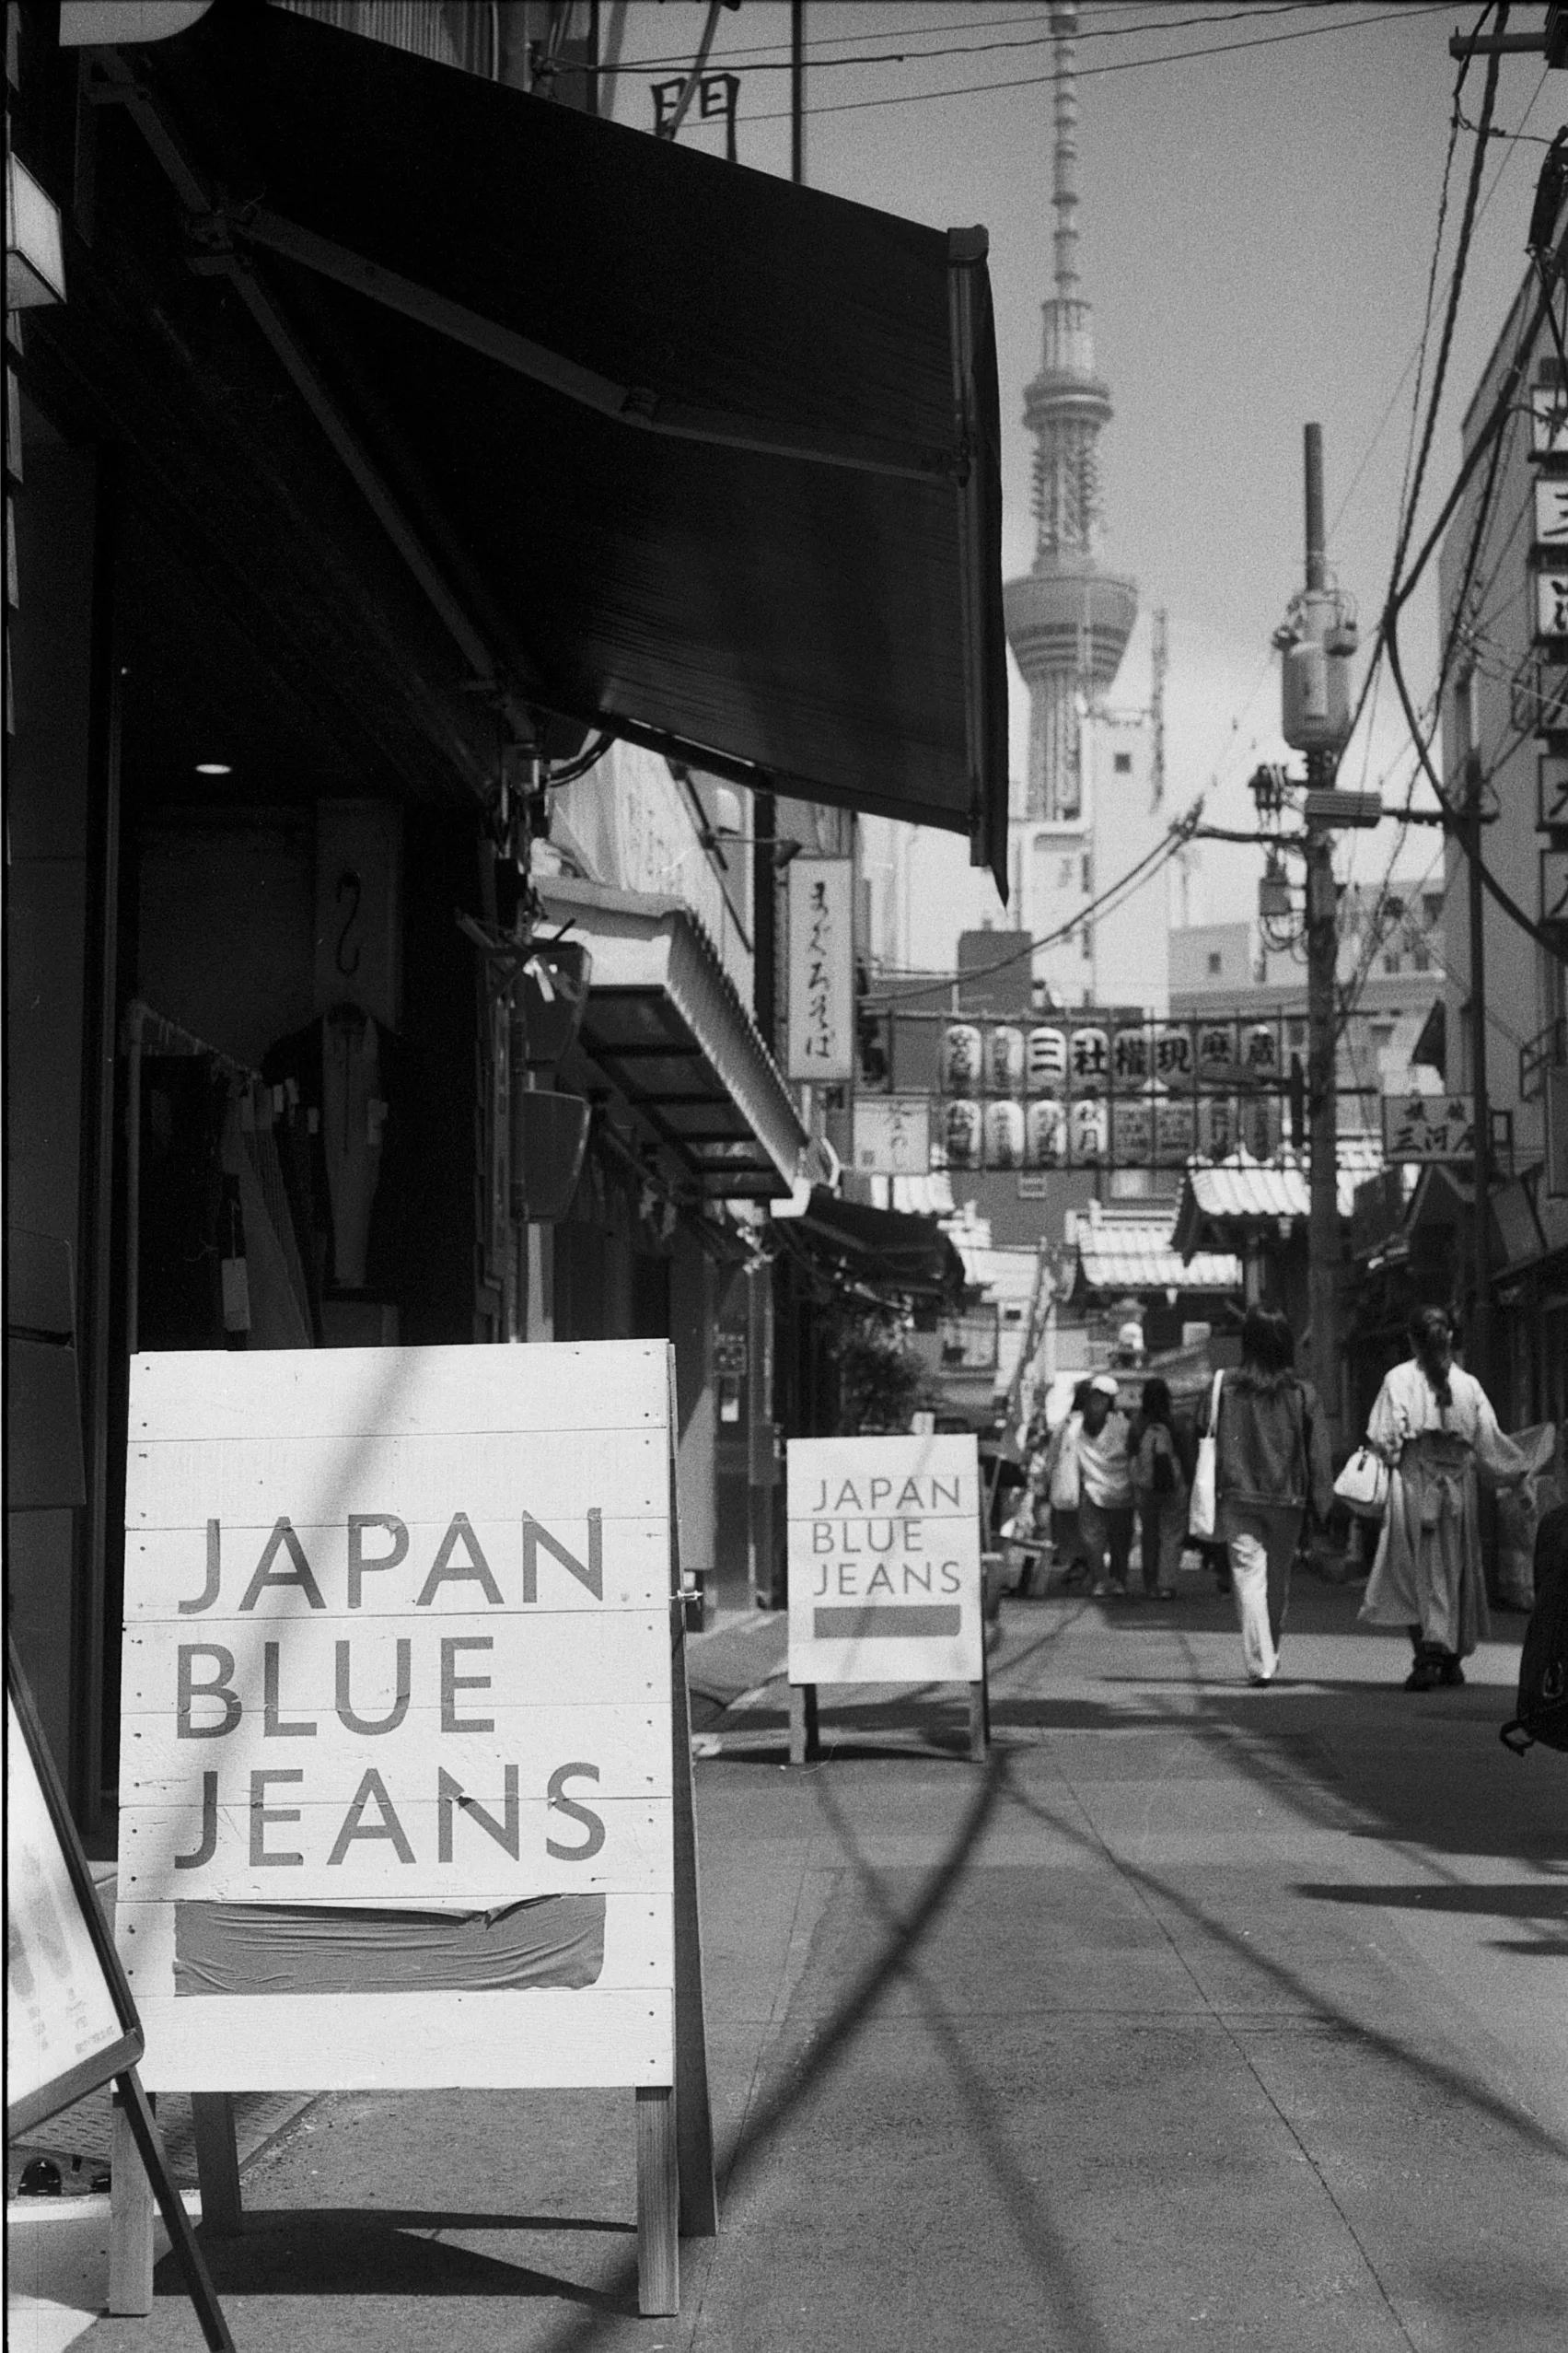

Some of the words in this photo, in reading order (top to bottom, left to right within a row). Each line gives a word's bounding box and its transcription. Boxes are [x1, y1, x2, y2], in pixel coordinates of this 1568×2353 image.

[812, 1476, 960, 1512] JAPAN
[178, 1507, 603, 1614] JAPAN
[812, 1520, 923, 1554] BLUE
[813, 1561, 961, 1597] JEANS
[176, 1636, 495, 1740] BLUE
[174, 1761, 607, 1870] JEANS
